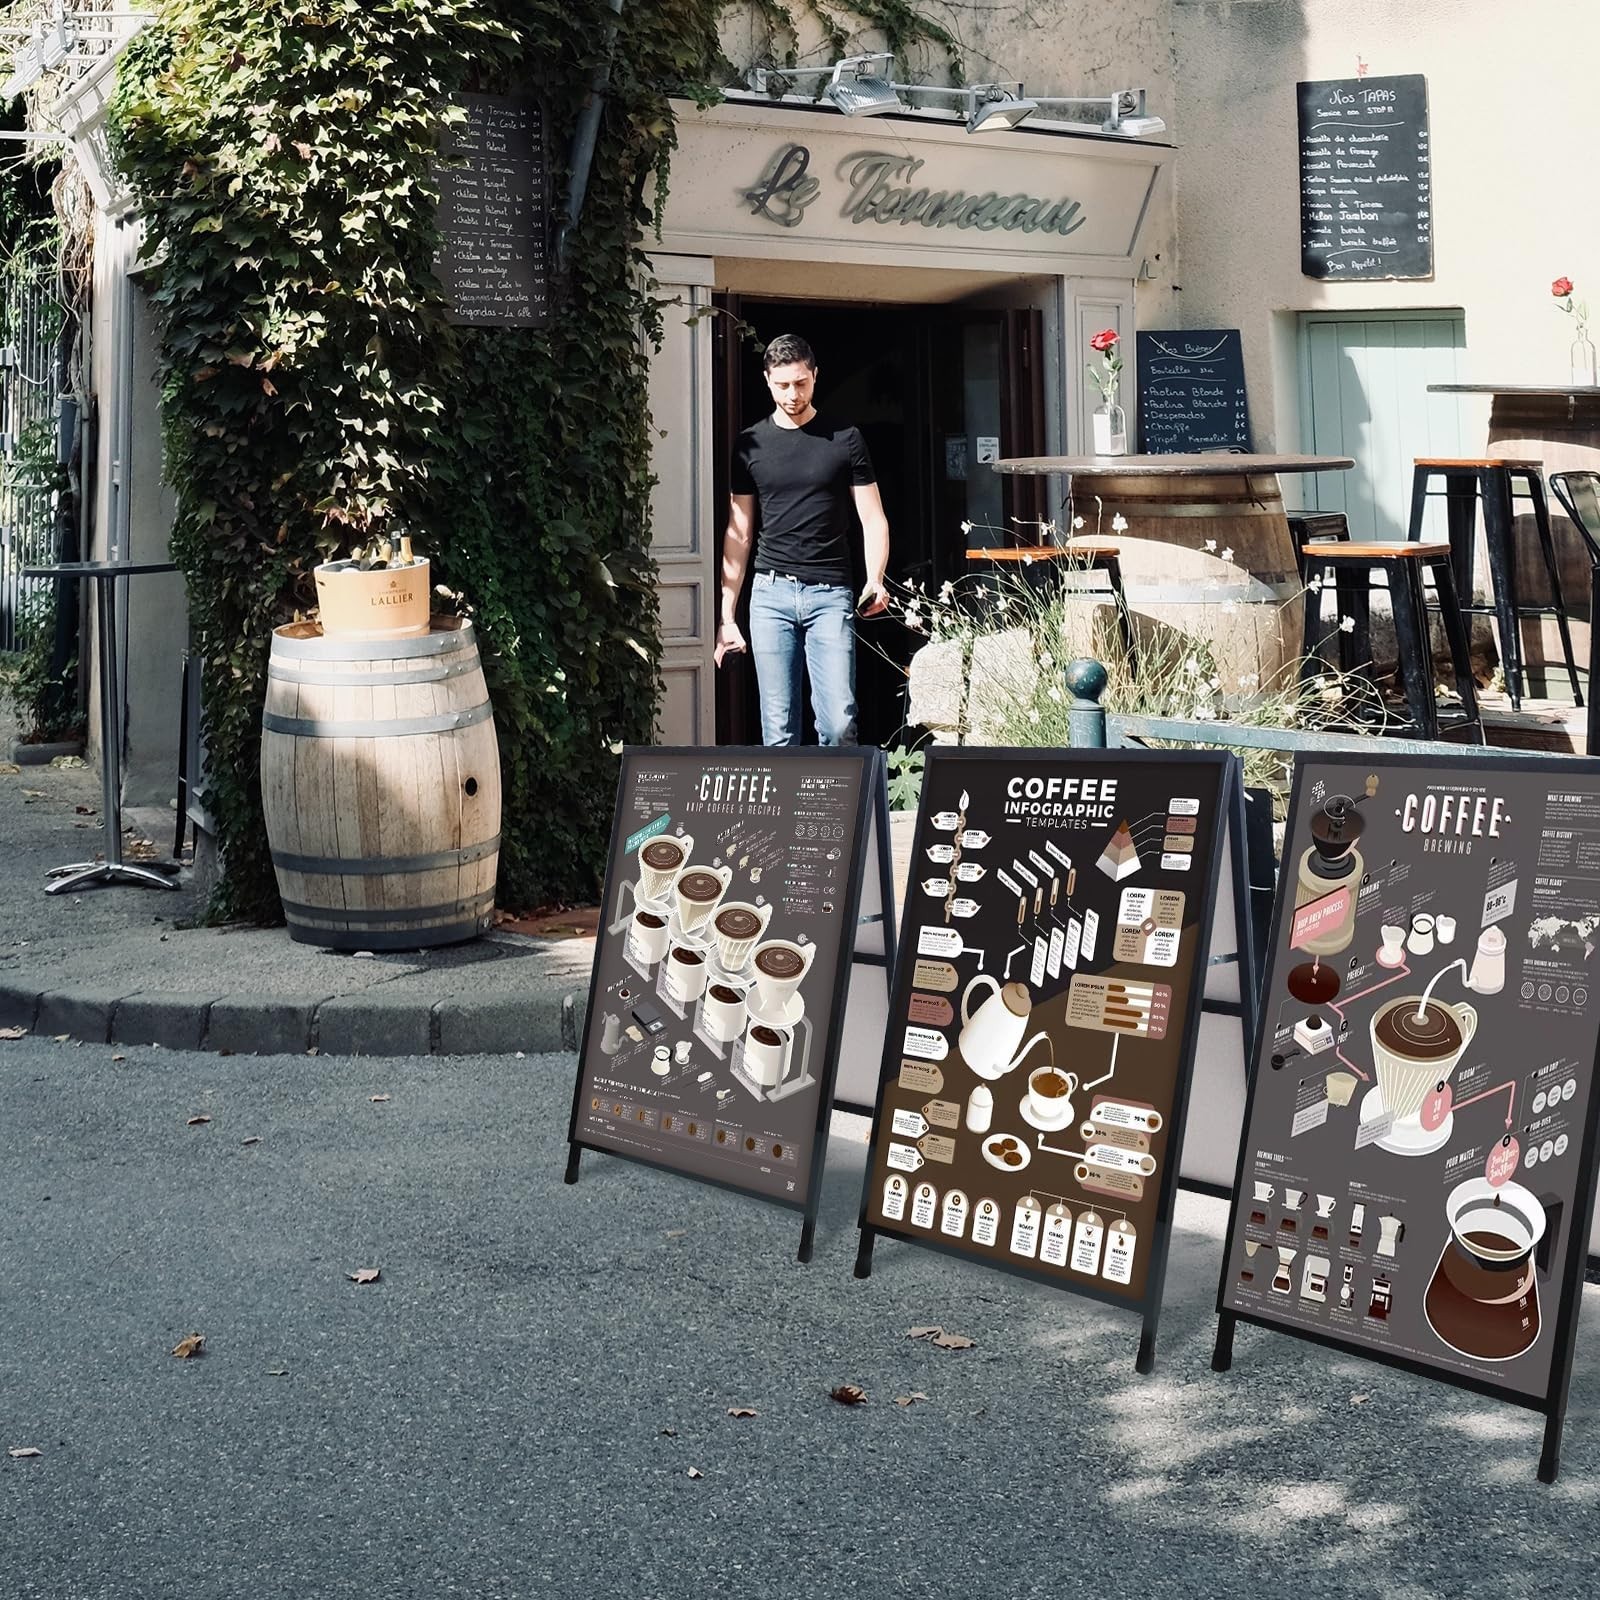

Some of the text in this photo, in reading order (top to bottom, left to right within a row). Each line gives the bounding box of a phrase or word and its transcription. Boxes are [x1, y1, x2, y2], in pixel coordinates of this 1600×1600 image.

[1329, 88, 1397, 104] Nos TAPAS
[1316, 109, 1342, 117] Service
[746, 145, 1086, 237] Le Tonneau
[1308, 210, 1379, 221] Melon Jambon
[1308, 240, 1333, 248] Tomate
[1341, 239, 1368, 247] burrata
[1326, 261, 1346, 273] Bon
[1191, 387, 1224, 397] Blonde
[1192, 400, 1228, 408] Blanche
[1150, 411, 1206, 421] Desperados
[1234, 421, 1246, 429] 6€
[1236, 432, 1247, 441] 6€
[371, 592, 414, 606] LALLIER
[700, 774, 772, 804] COFFEE
[1007, 776, 1118, 802] COFFEE
[707, 803, 735, 815] COFFEE
[748, 804, 781, 816] RECIPES
[1004, 801, 1115, 819] INFOGRAPHIC
[1402, 793, 1505, 839] COFFEE
[1025, 816, 1088, 830] TEMPLATES
[1424, 838, 1472, 855] BREWING
[1121, 927, 1141, 935] LOREM
[953, 1195, 960, 1204] C
[985, 1204, 990, 1212] D
